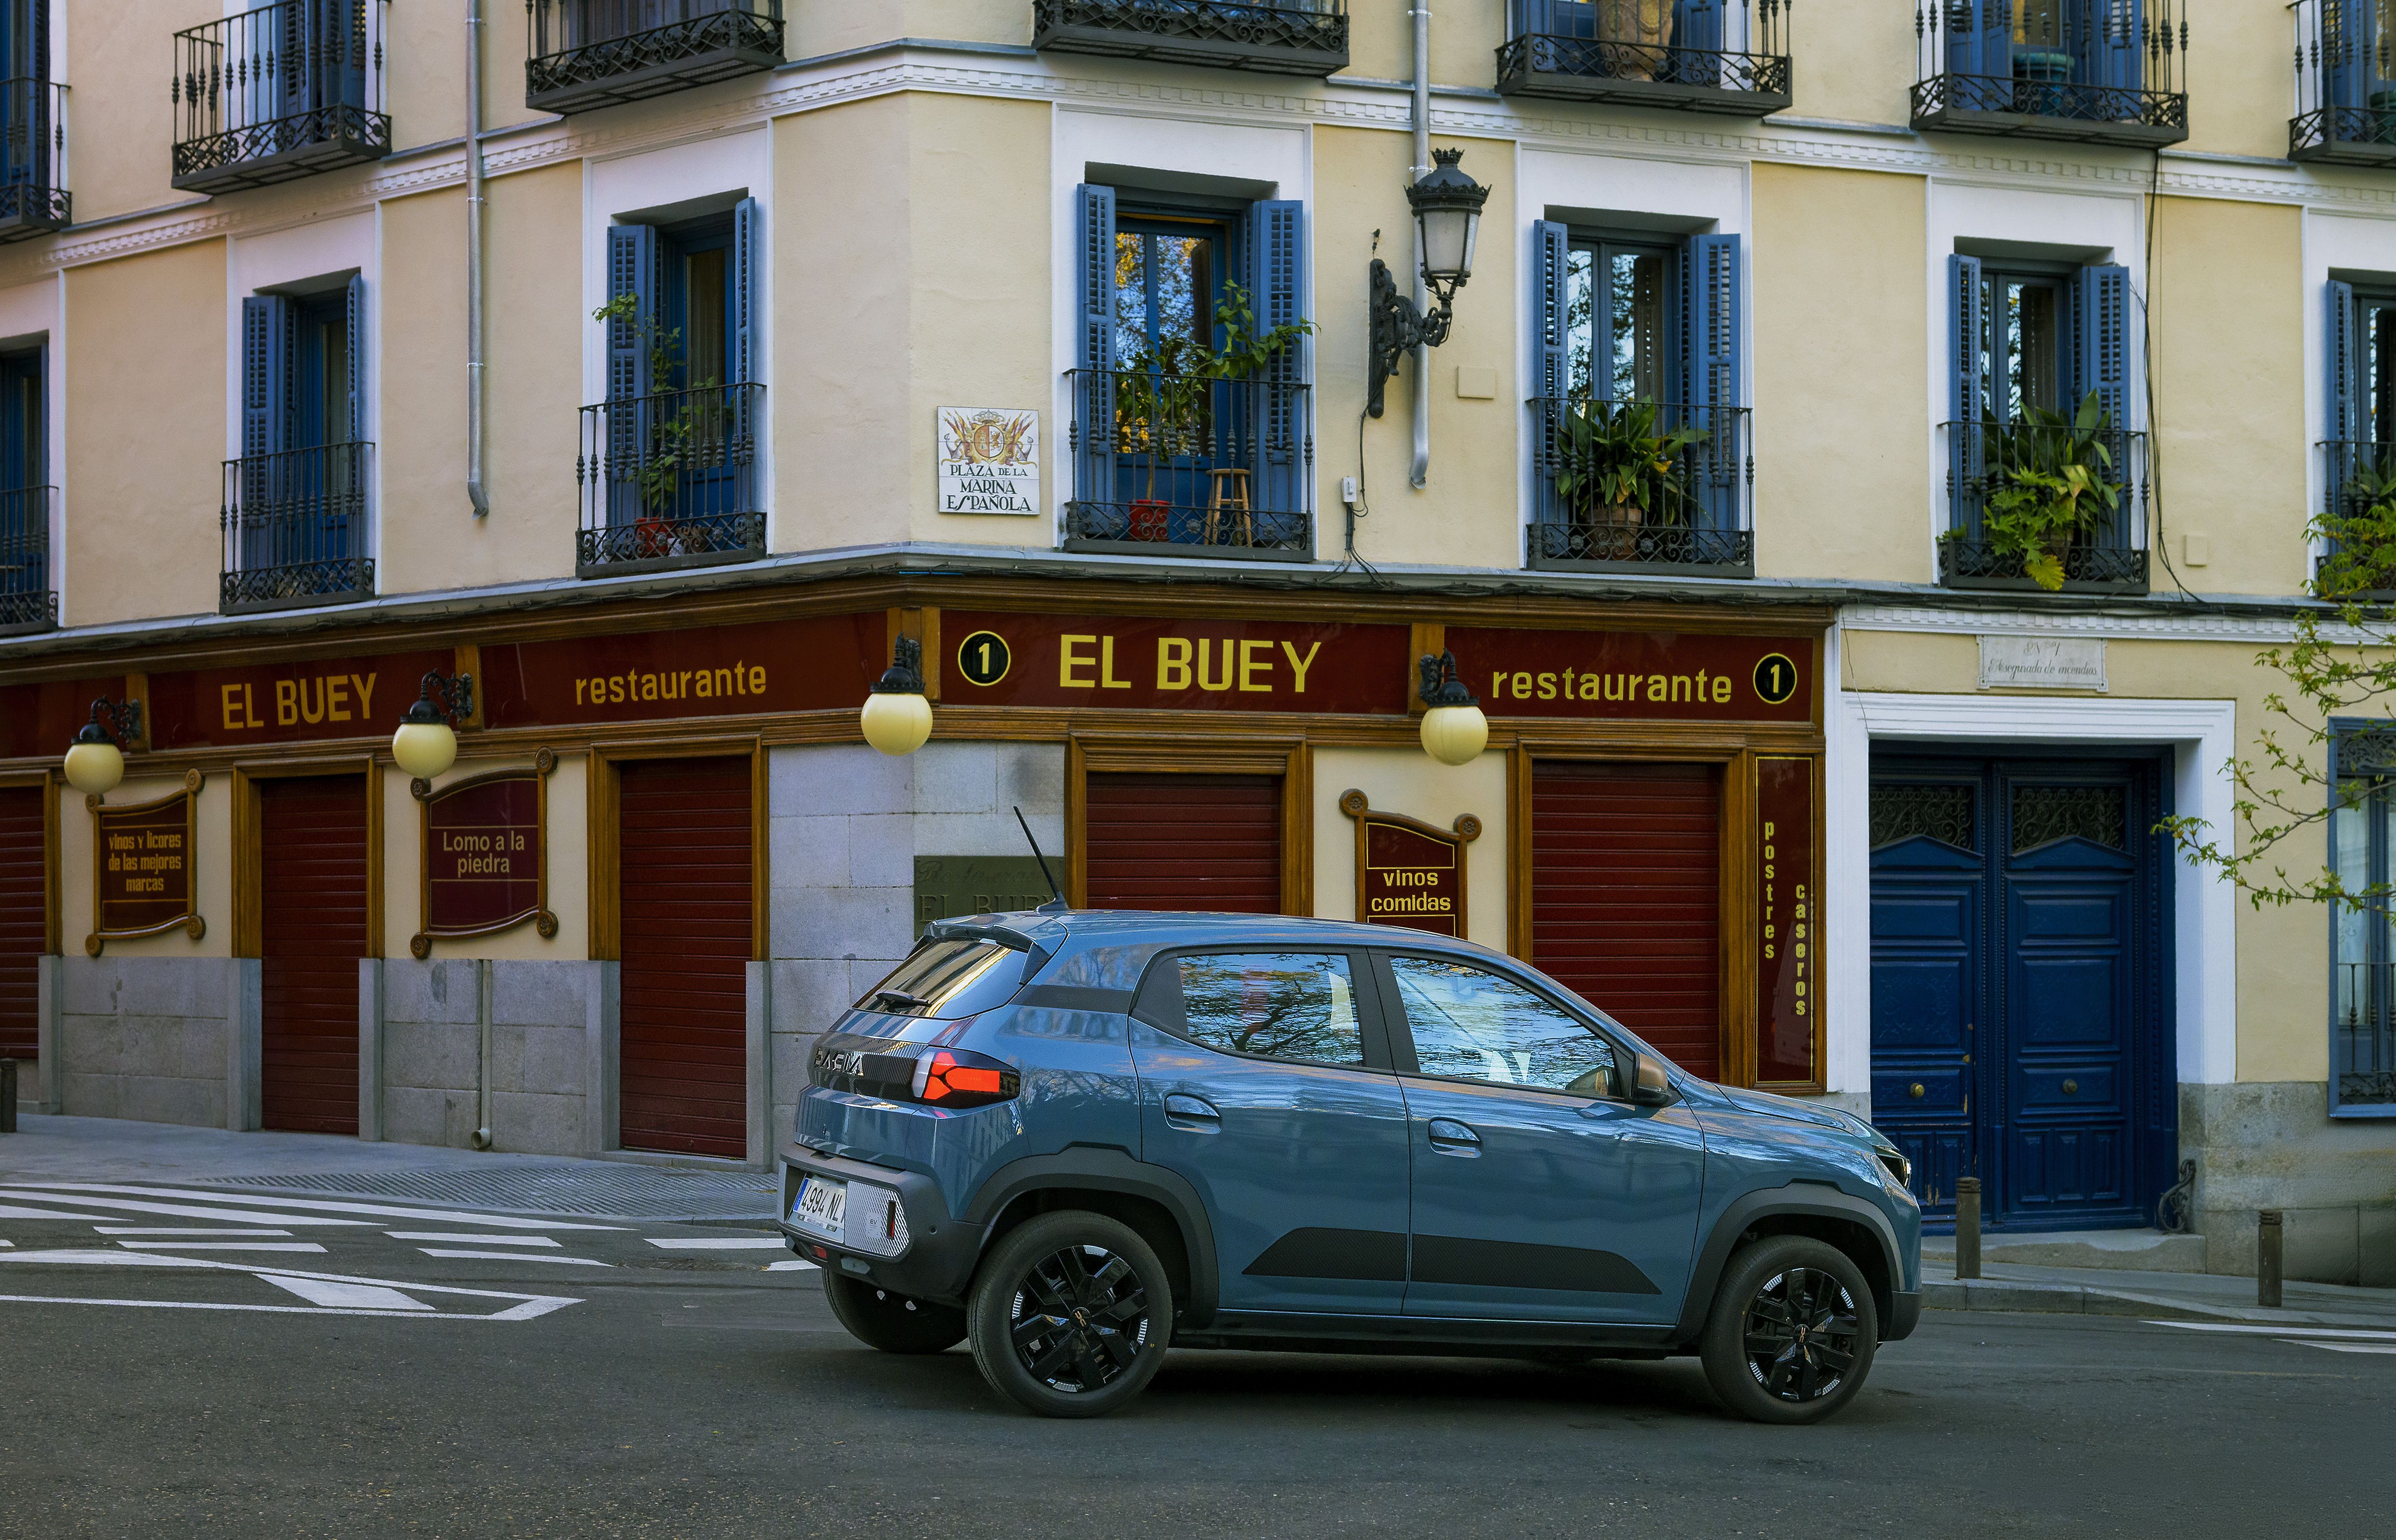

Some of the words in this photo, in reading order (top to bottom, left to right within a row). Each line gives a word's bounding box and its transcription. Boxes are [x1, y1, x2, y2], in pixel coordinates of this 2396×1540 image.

[950, 464, 995, 477] PLAZA
[998, 467, 1011, 476] DE
[1013, 468, 1028, 476] LA
[960, 479, 1017, 494] MARINA
[947, 494, 1033, 511] ESPAÑOLA
[978, 643, 990, 675] 1
[1060, 634, 1131, 689] EL
[1157, 637, 1321, 693] BUEY
[2044, 659, 2056, 674] de
[575, 659, 767, 706] restaurante
[1492, 666, 1732, 704] restaurante
[1770, 664, 1780, 694] 1
[221, 683, 264, 730] EL
[276, 672, 378, 726] BUEY
[109, 834, 135, 850] vinos
[147, 830, 181, 848] licores
[443, 831, 490, 851] Lomo
[495, 835, 505, 851] a
[510, 830, 525, 851] la
[108, 852, 120, 871] de
[123, 852, 138, 871] las
[140, 853, 182, 875] mejores
[458, 853, 510, 878] piedra
[126, 878, 164, 892] marcas
[1383, 869, 1439, 887] vinos
[1765, 821, 1774, 959] postres
[1371, 891, 1451, 912] comidas
[1796, 884, 1806, 1016] caseros
[801, 1185, 829, 1216] 4994
[825, 1193, 846, 1224] NL
